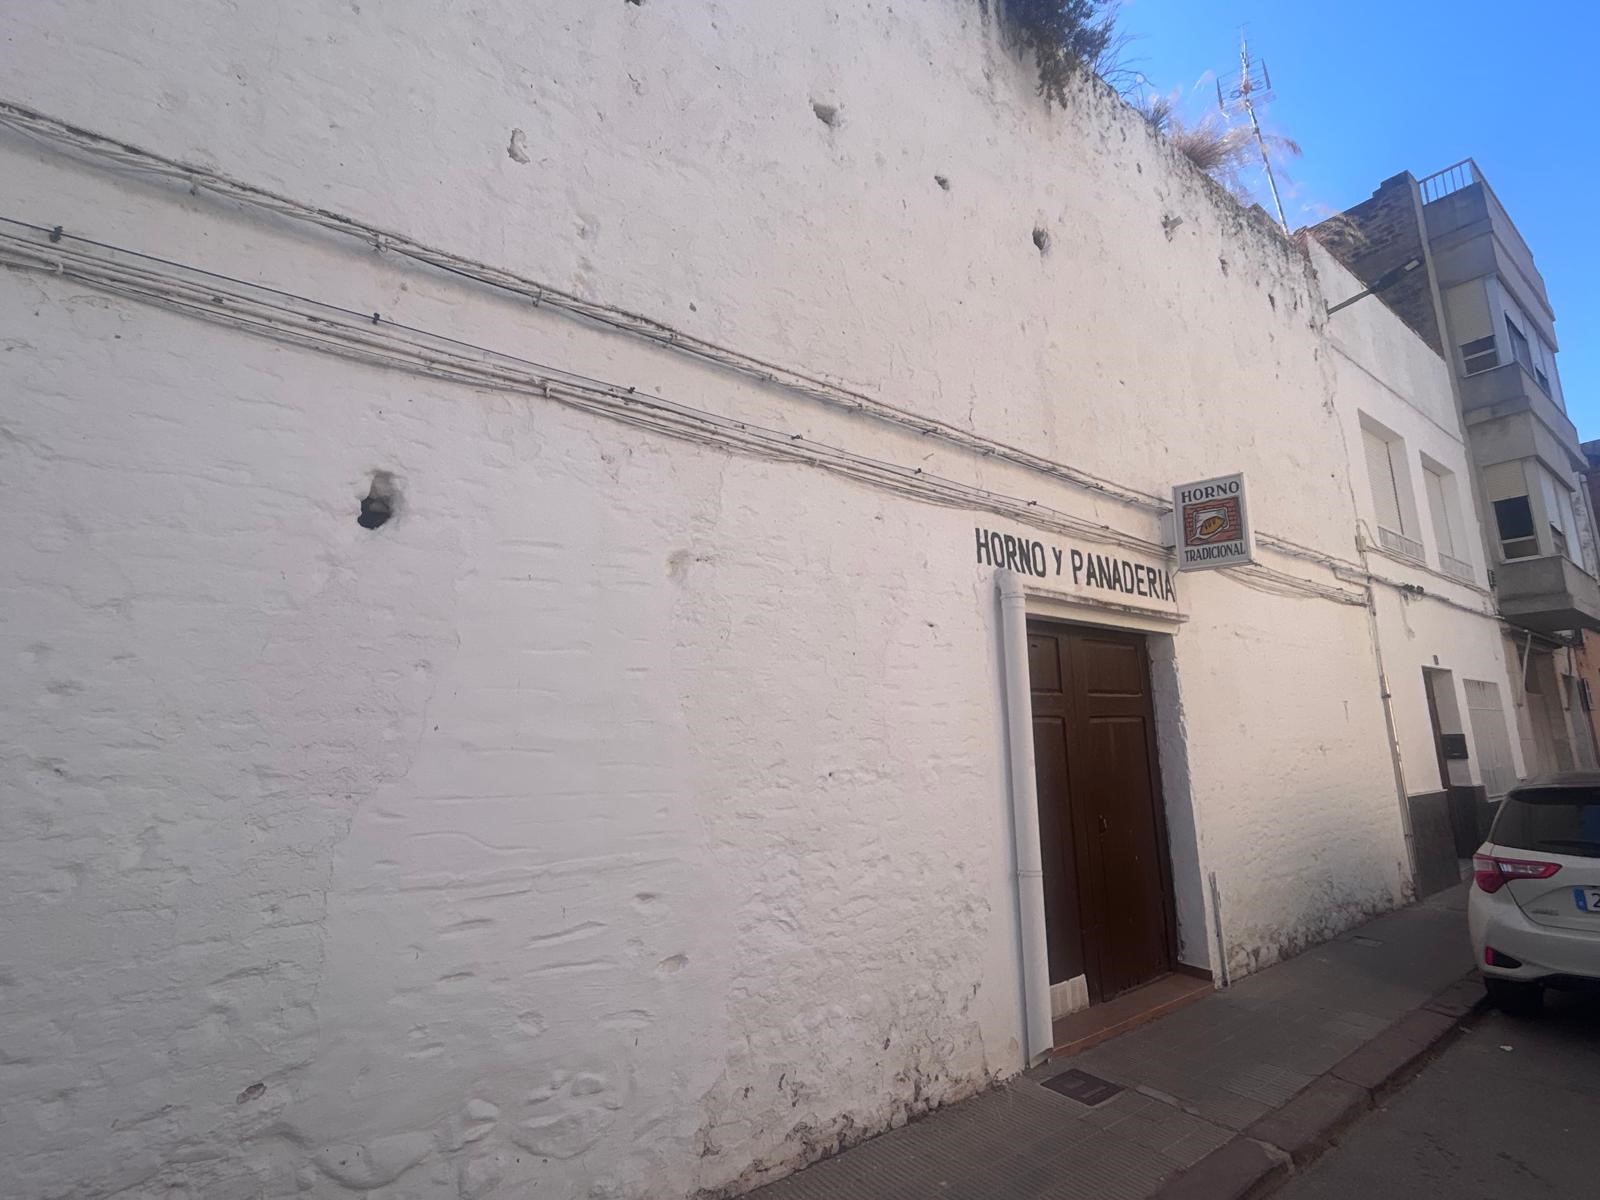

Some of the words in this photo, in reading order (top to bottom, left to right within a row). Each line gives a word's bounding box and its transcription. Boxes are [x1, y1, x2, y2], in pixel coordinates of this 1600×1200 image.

[1181, 481, 1239, 503] HORNO
[1184, 542, 1245, 562] TRADICIONAL
[975, 527, 1046, 578] HORNO
[1052, 547, 1062, 576] Y
[1071, 549, 1175, 602] PANADERIA
